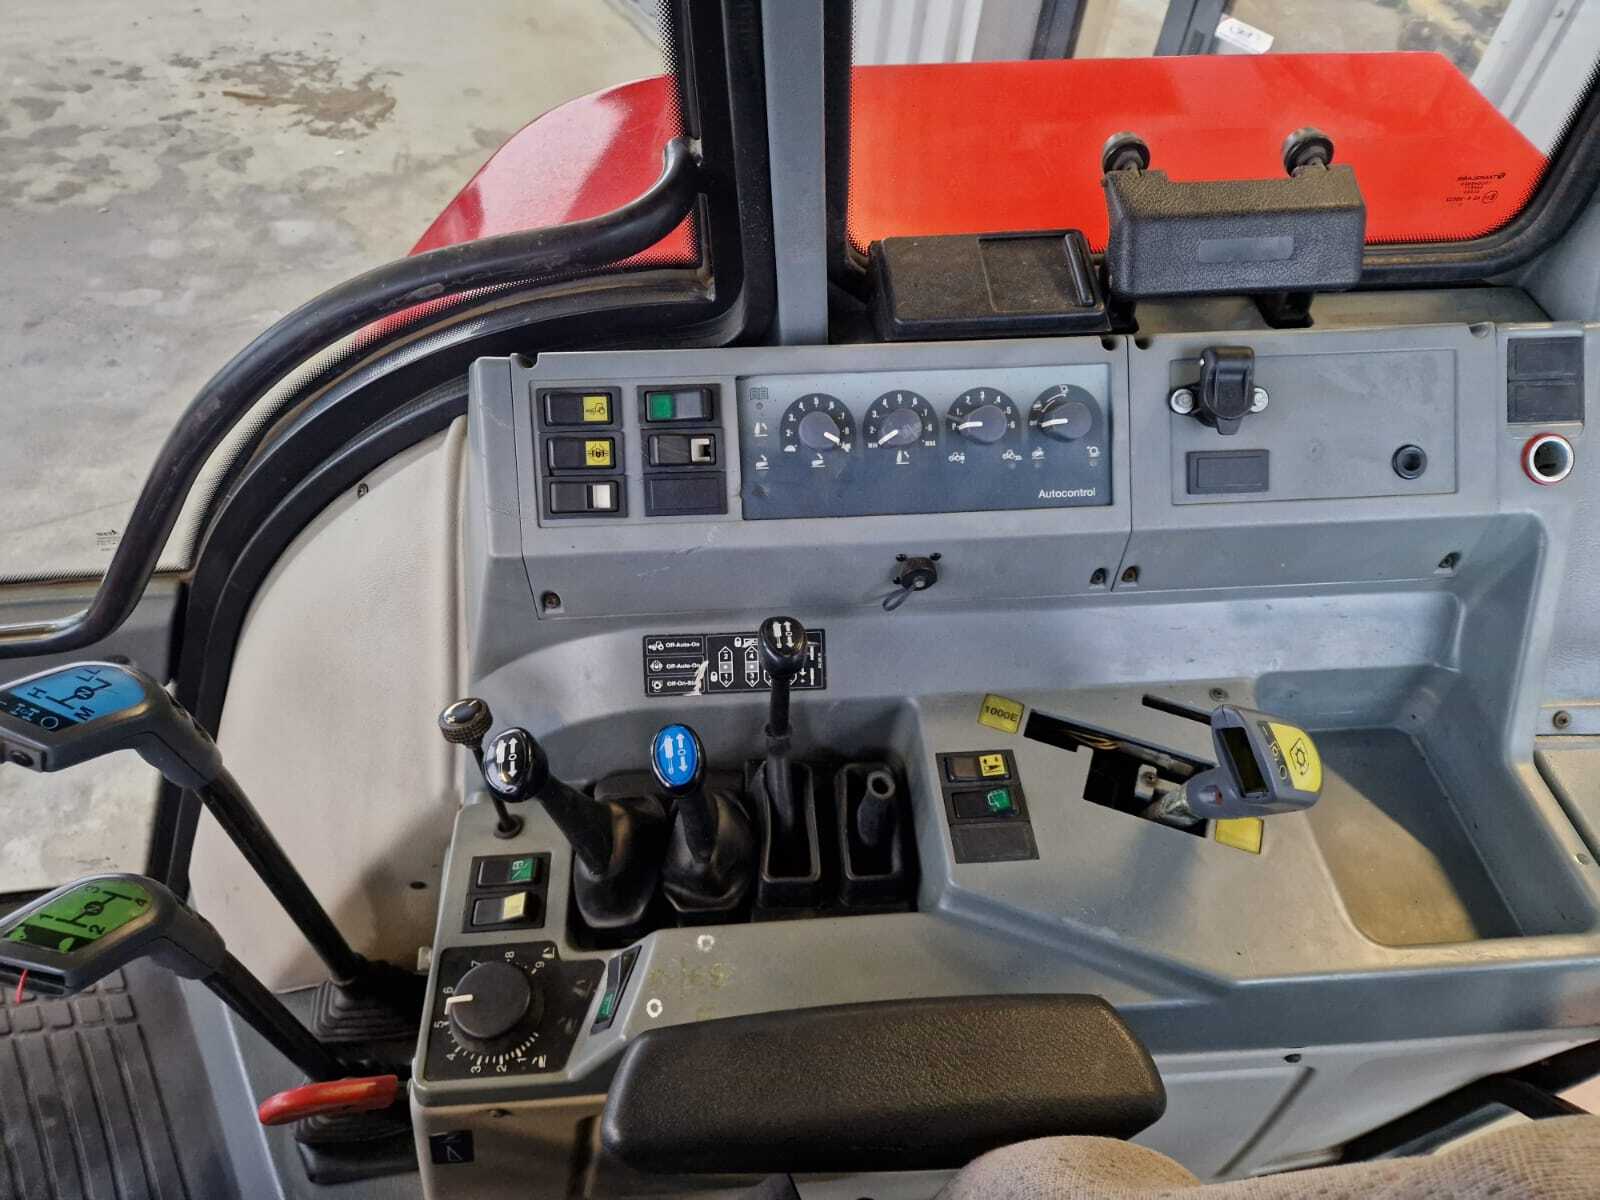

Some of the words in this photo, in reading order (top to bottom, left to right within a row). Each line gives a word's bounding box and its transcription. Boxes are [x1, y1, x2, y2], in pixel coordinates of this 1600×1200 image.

[1038, 488, 1096, 499] Autocontrol
[27, 687, 48, 699] H
[74, 705, 96, 720] M
[985, 705, 1017, 722] 1000E
[88, 924, 106, 935] 2
[505, 951, 515, 959] 8
[535, 961, 545, 969] 9
[443, 986, 454, 994] 6
[434, 1020, 444, 1029] 5
[446, 1052, 457, 1061] 4
[470, 1065, 481, 1074] 3
[496, 1064, 507, 1073] 2
